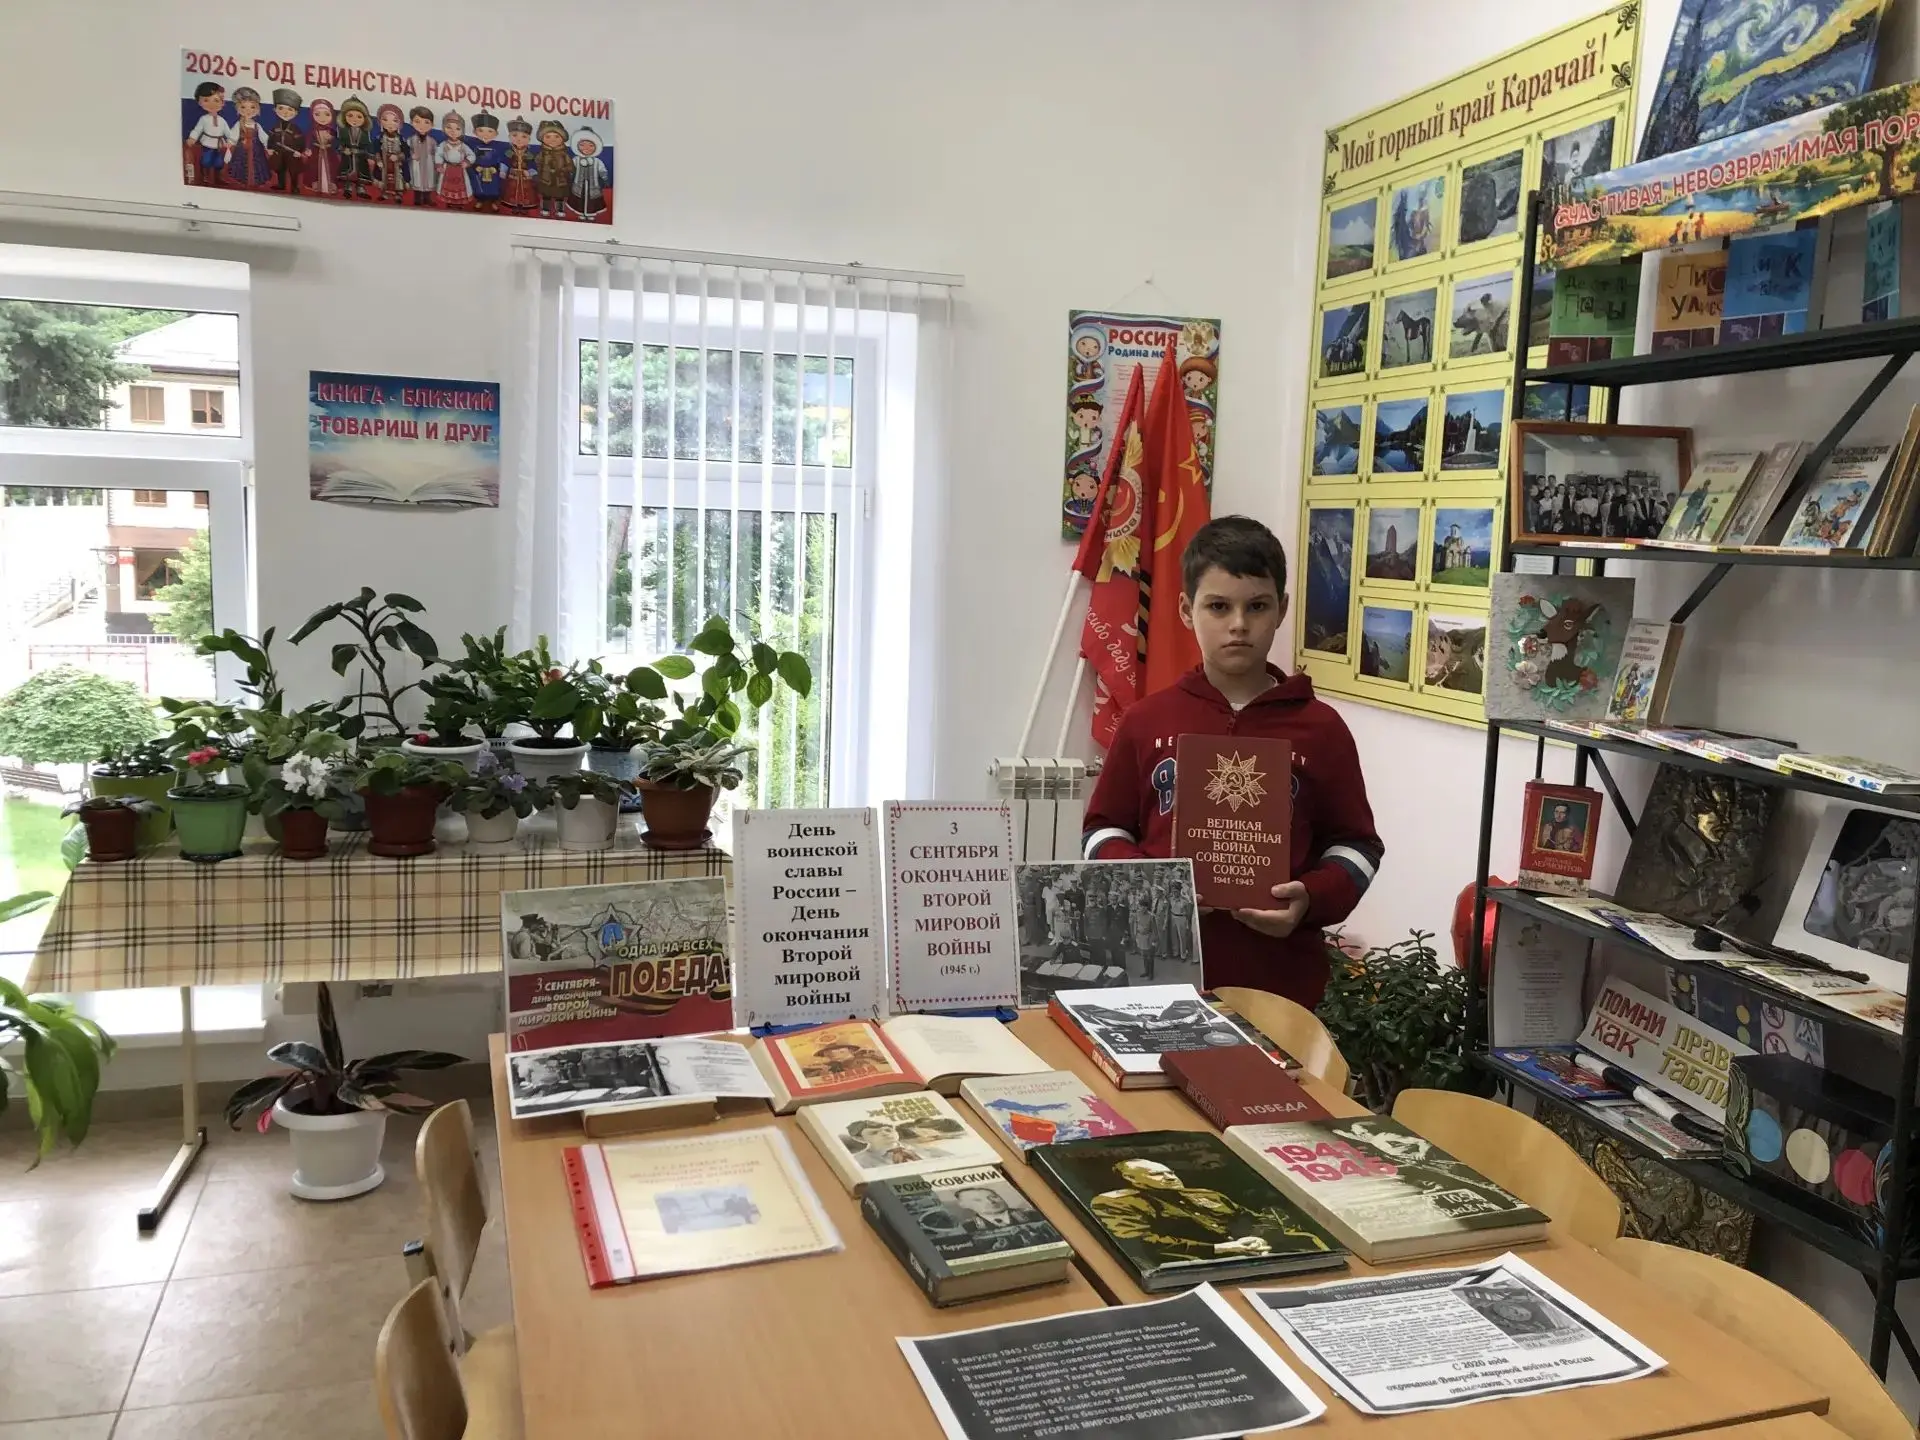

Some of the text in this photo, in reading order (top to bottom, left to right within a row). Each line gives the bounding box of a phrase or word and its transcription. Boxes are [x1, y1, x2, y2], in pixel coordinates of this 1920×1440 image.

[184, 52, 610, 120] 2026-ГОД ЕДИНСТВА НАРОДОВ РОССИИ
[1340, 32, 1607, 172] Мой горный край Карачай!
[1672, 126, 1858, 196] НЕВОЗВРАТИМАЯ
[1864, 112, 1920, 149] ПОР
[1109, 329, 1178, 346] РОССИЯ
[1108, 346, 1149, 358] Родина
[317, 382, 494, 411] КНИГА БЛИЗКИЙ
[318, 415, 492, 442] ТОВАРИЩ И ДРУГ
[1106, 638, 1131, 673] деду
[1156, 736, 1172, 748] NE
[1292, 752, 1307, 766] TY
[788, 822, 836, 840] День
[950, 822, 958, 835] 3
[1206, 818, 1262, 831] ВЕЛИКАЯ
[1188, 828, 1282, 844] ОТЕЧЕСТВЕННАЯ
[767, 840, 858, 858] воинской
[910, 844, 1000, 859] СЕНТЯБРЯ
[1213, 840, 1256, 854] ВОЙНА
[1196, 852, 1270, 866] СОВЕТСКОГО
[785, 865, 842, 878] славы
[900, 868, 1010, 884] ОКОНЧАНИЕ
[1213, 864, 1255, 877] СОЮЗА
[772, 885, 840, 900] России
[922, 888, 992, 908] ВТОРОЙ
[792, 905, 840, 922] День
[914, 914, 1000, 932] МИРОВОЙ
[762, 926, 870, 944] окончания
[618, 938, 715, 958] ОДНА НА ВСЕХ
[782, 944, 852, 968] Второй
[927, 940, 992, 956] ВОЙНЫ
[610, 953, 727, 998] ПОБЕДА
[774, 966, 860, 986] мировой
[940, 964, 981, 976] (1945 г.)
[535, 976, 544, 992] 3
[531, 990, 602, 1005] ДЕНЬ ОКОНЧАНИЯ
[546, 999, 590, 1013] ВТОРОЙ
[786, 990, 852, 1008] войны
[518, 1007, 618, 1026] МИРОВОЙ ВОЙНЫ
[1599, 988, 1667, 1038] ПОМНИ
[1110, 1032, 1128, 1042] 3
[1242, 1102, 1308, 1116] ПОБЕДА
[1031, 1341, 1060, 1350] СССР
[1061, 1333, 1114, 1345] объявляет
[1142, 1322, 1178, 1331] Японии
[973, 1369, 1013, 1379] течение
[1022, 1361, 1058, 1371] недель
[1059, 1352, 1110, 1364] советские
[1109, 1346, 1143, 1354] войска
[1145, 1337, 1201, 1350] разгромили
[1004, 1346, 1085, 1363] наступательную
[1084, 1338, 1134, 1349] операцию
[1034, 1368, 1069, 1377] армию
[1078, 1358, 1125, 1370] очистили
[1452, 1356, 1510, 1371] С 2020 года
[972, 1387, 1003, 1397] Китай
[1063, 1371, 1095, 1380] Также
[1094, 1366, 1123, 1375] были
[1386, 1378, 1438, 1392] окончание
[1438, 1371, 1480, 1386] Второй
[1481, 1366, 1522, 1378] мировой
[1522, 1362, 1554, 1373] войны
[1560, 1356, 1594, 1367] России
[1450, 1379, 1503, 1394] отмечают
[1513, 1372, 1560, 1386] сентября
[977, 1391, 1038, 1406] Курильские
[1082, 1375, 1126, 1386] Сахалин
[991, 1402, 1041, 1415] сентября
[1089, 1386, 1121, 1397] борту
[1121, 1374, 1194, 1391] американского
[1195, 1367, 1237, 1378] линкора
[1056, 1398, 1111, 1411] Токийском
[1112, 1391, 1149, 1401] заливе
[1149, 1382, 1196, 1394] японская
[1034, 1393, 1254, 1436] ВТОРАЯ МИРОВАЯ ВОЙНА ЗАВЕРШИЛАСЬ
[994, 1418, 1052, 1432] подписала
